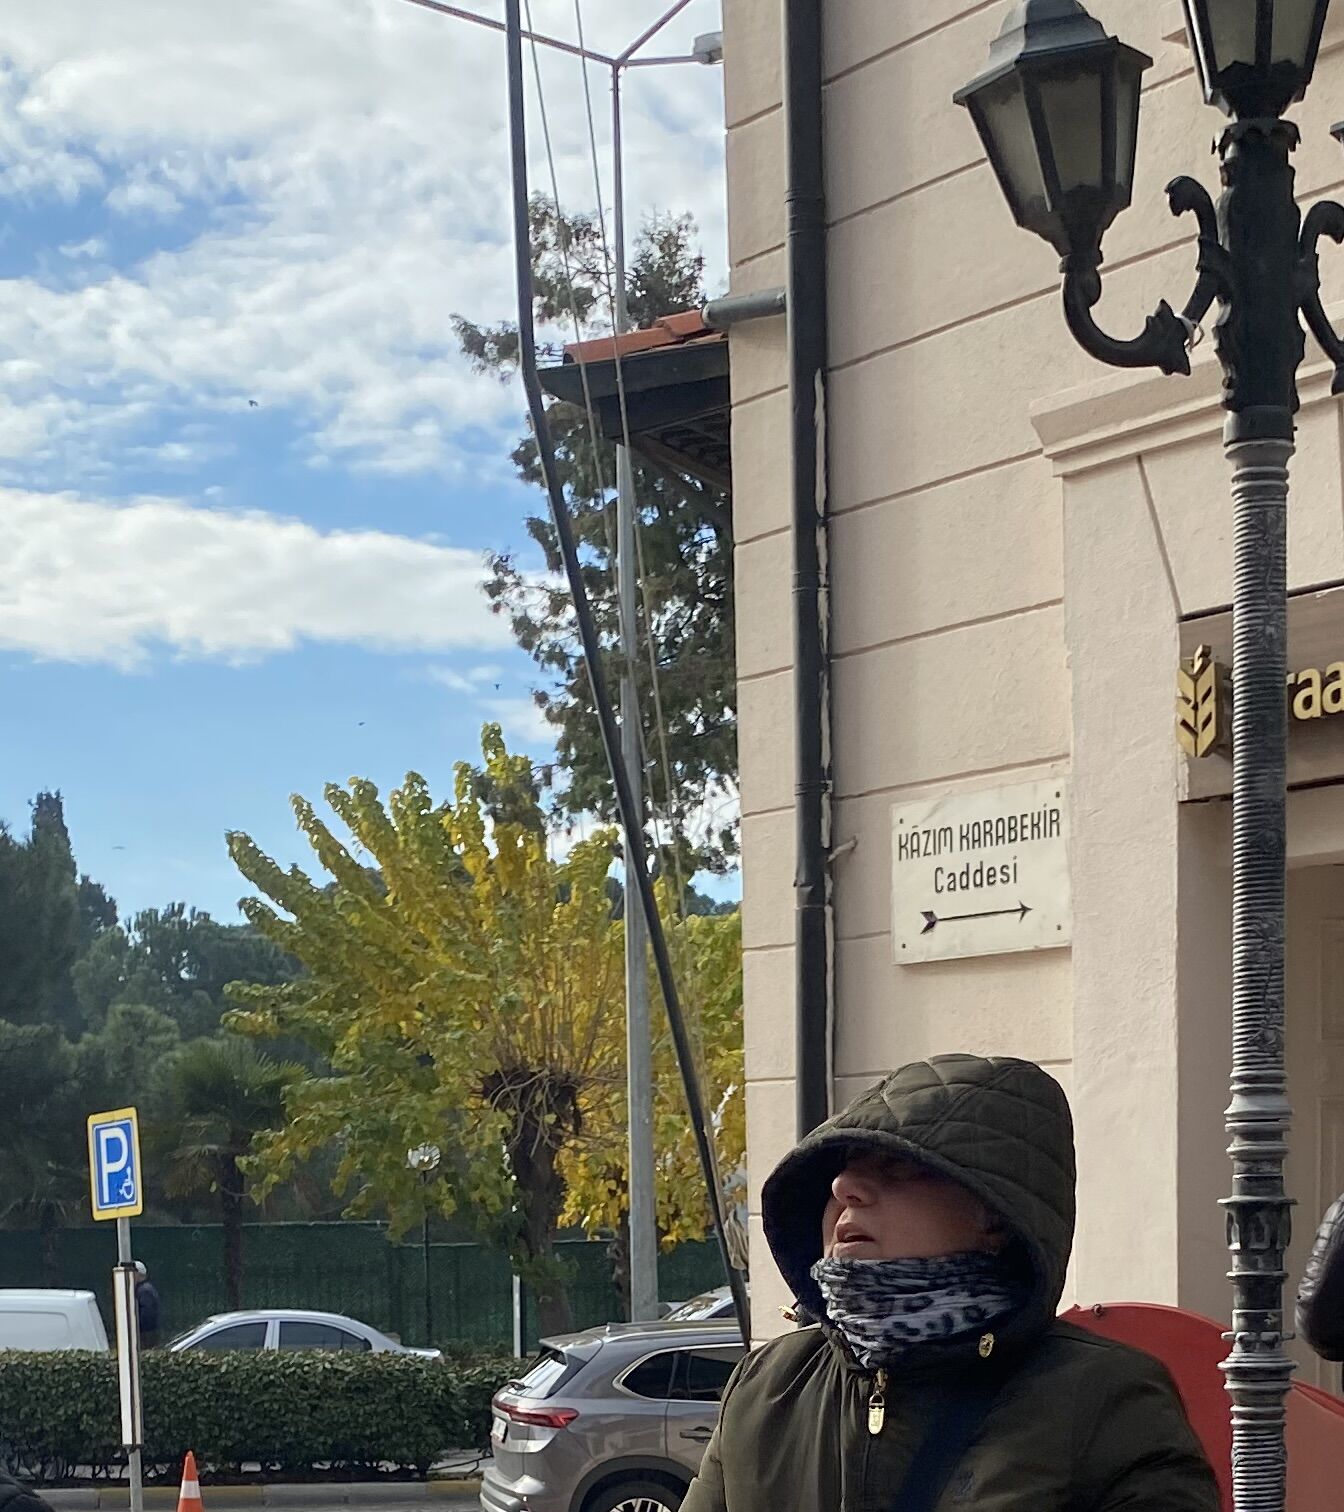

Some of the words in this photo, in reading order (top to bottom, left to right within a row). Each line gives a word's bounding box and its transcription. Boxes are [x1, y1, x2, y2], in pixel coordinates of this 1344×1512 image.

[959, 803, 1061, 852] KARABEKİR
[934, 855, 1018, 894] Caddesi
[99, 1127, 129, 1204] P
